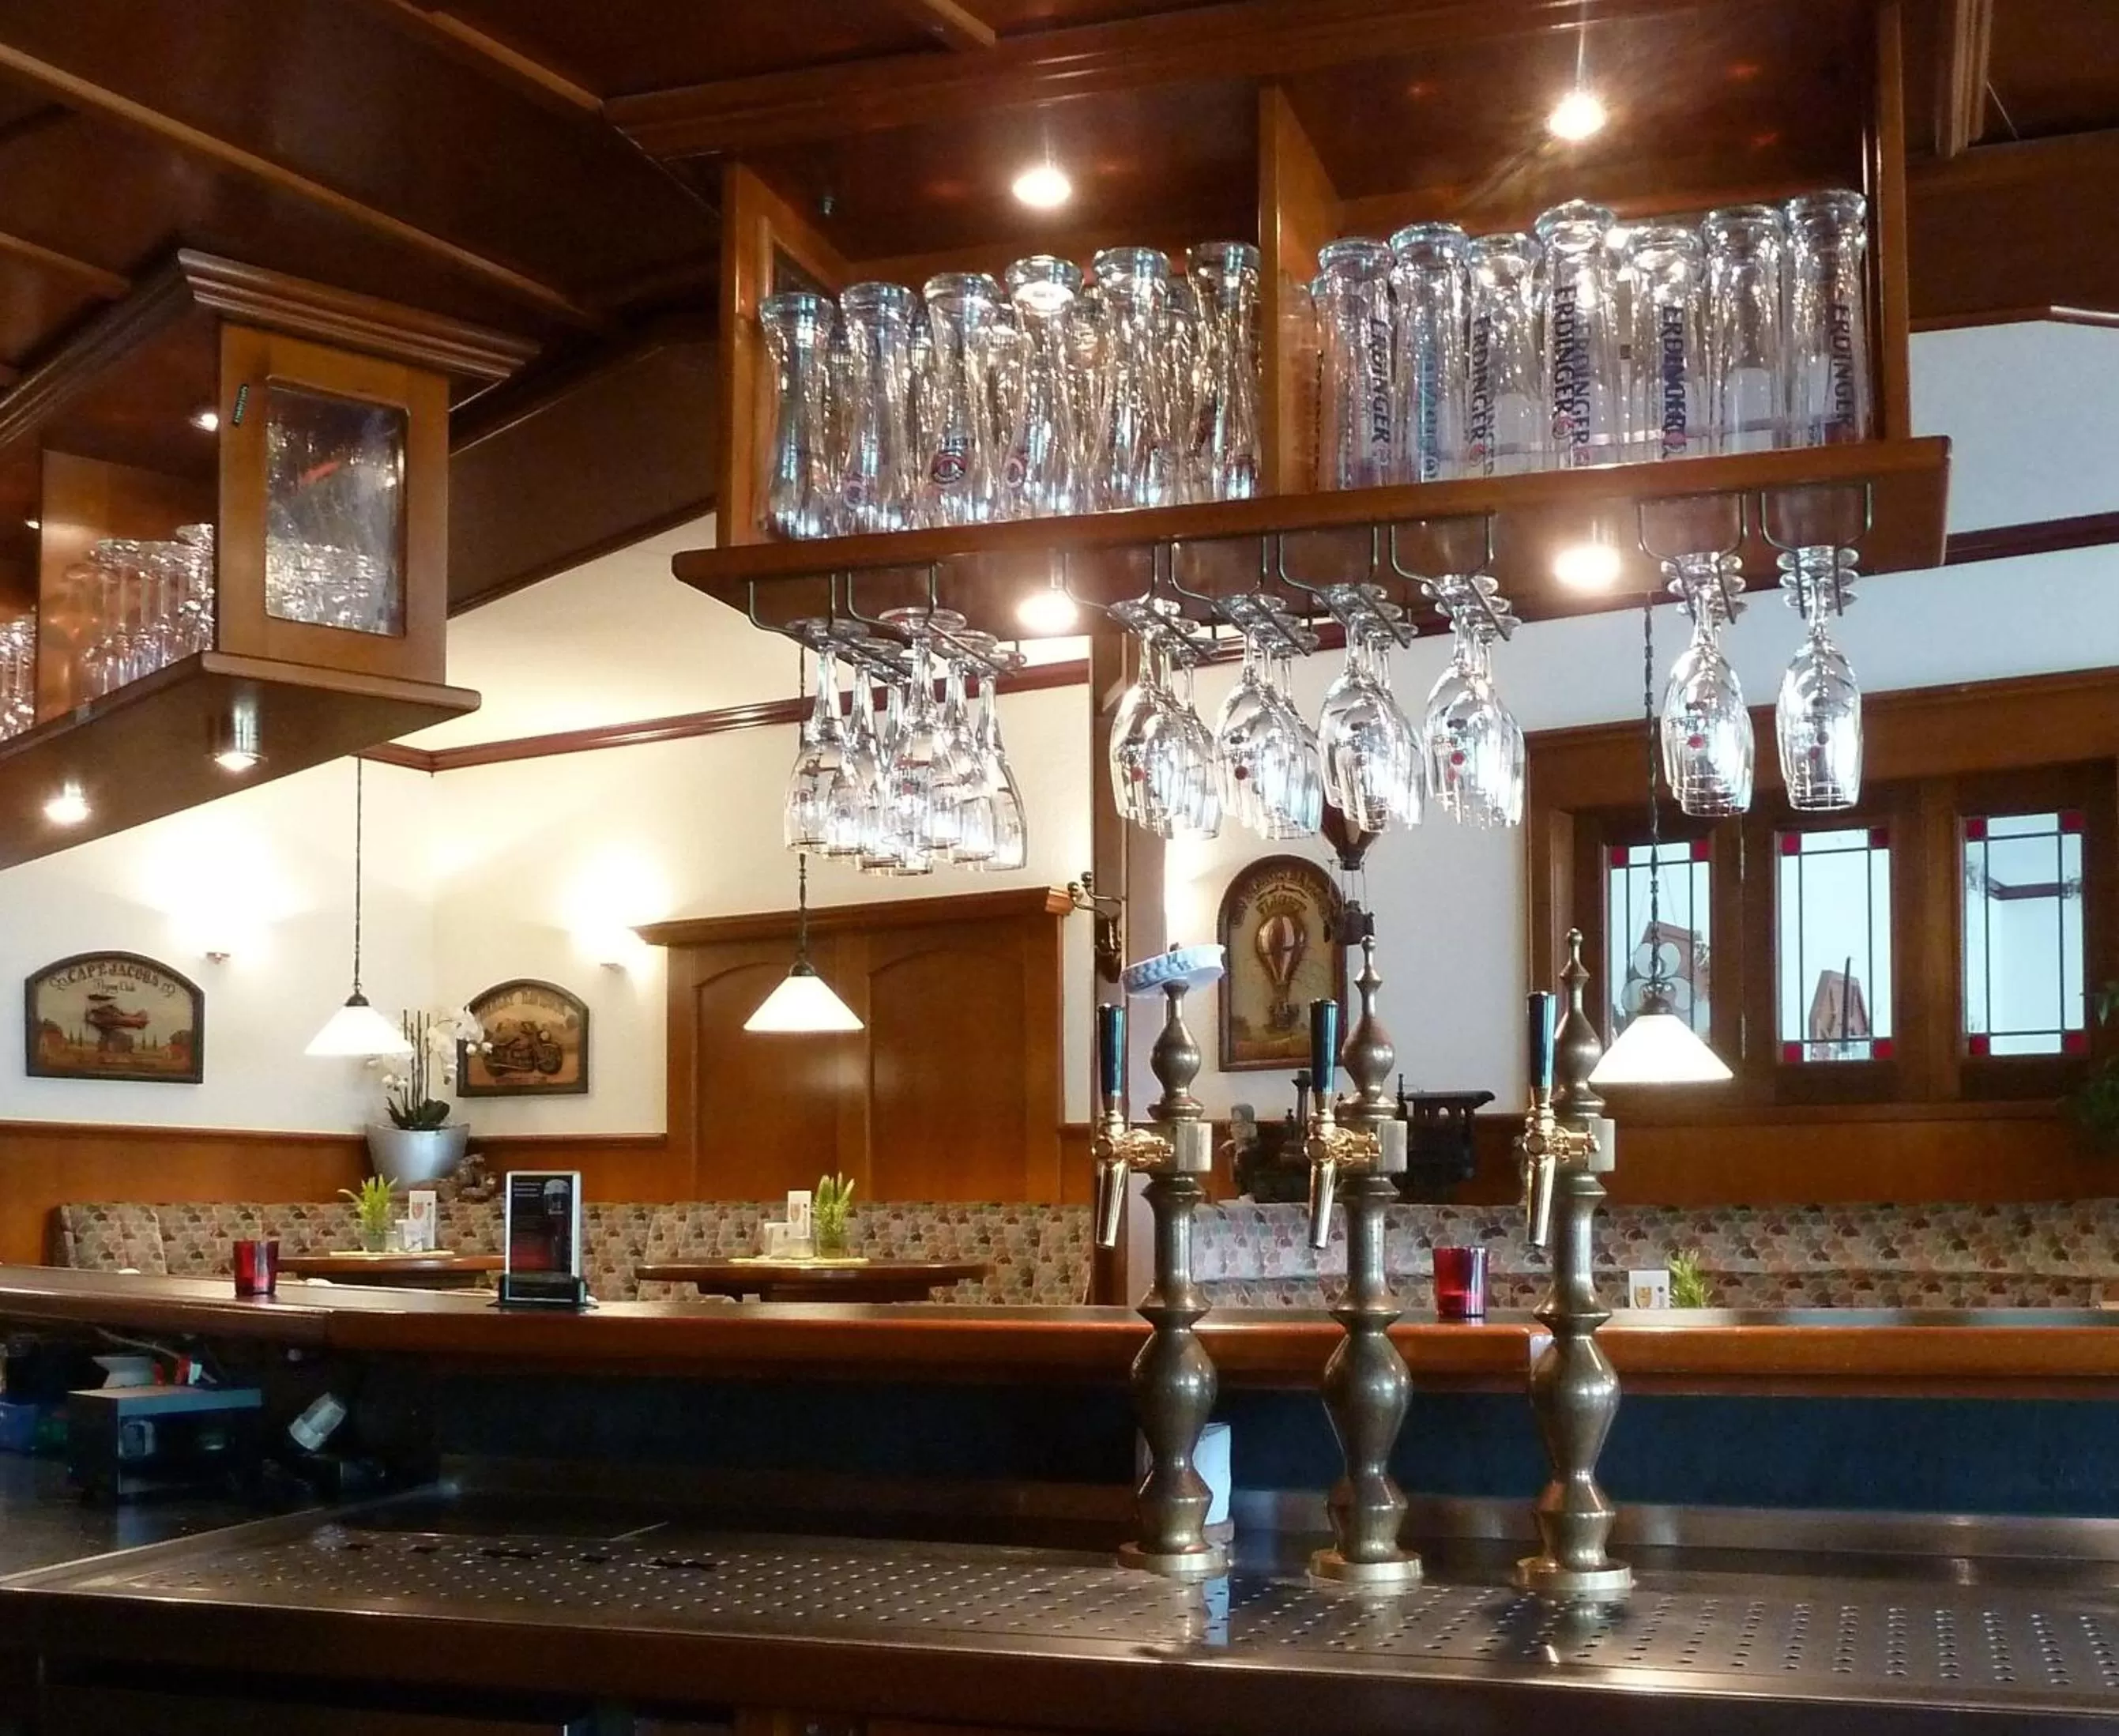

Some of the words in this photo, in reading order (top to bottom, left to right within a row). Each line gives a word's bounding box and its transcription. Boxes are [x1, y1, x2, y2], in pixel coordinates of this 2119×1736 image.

[1368, 317, 1391, 444] ERDINGER
[1469, 315, 1492, 445] ERDINGER
[1553, 285, 1578, 420] ERDINGER
[1830, 303, 1855, 427] ERDINGER
